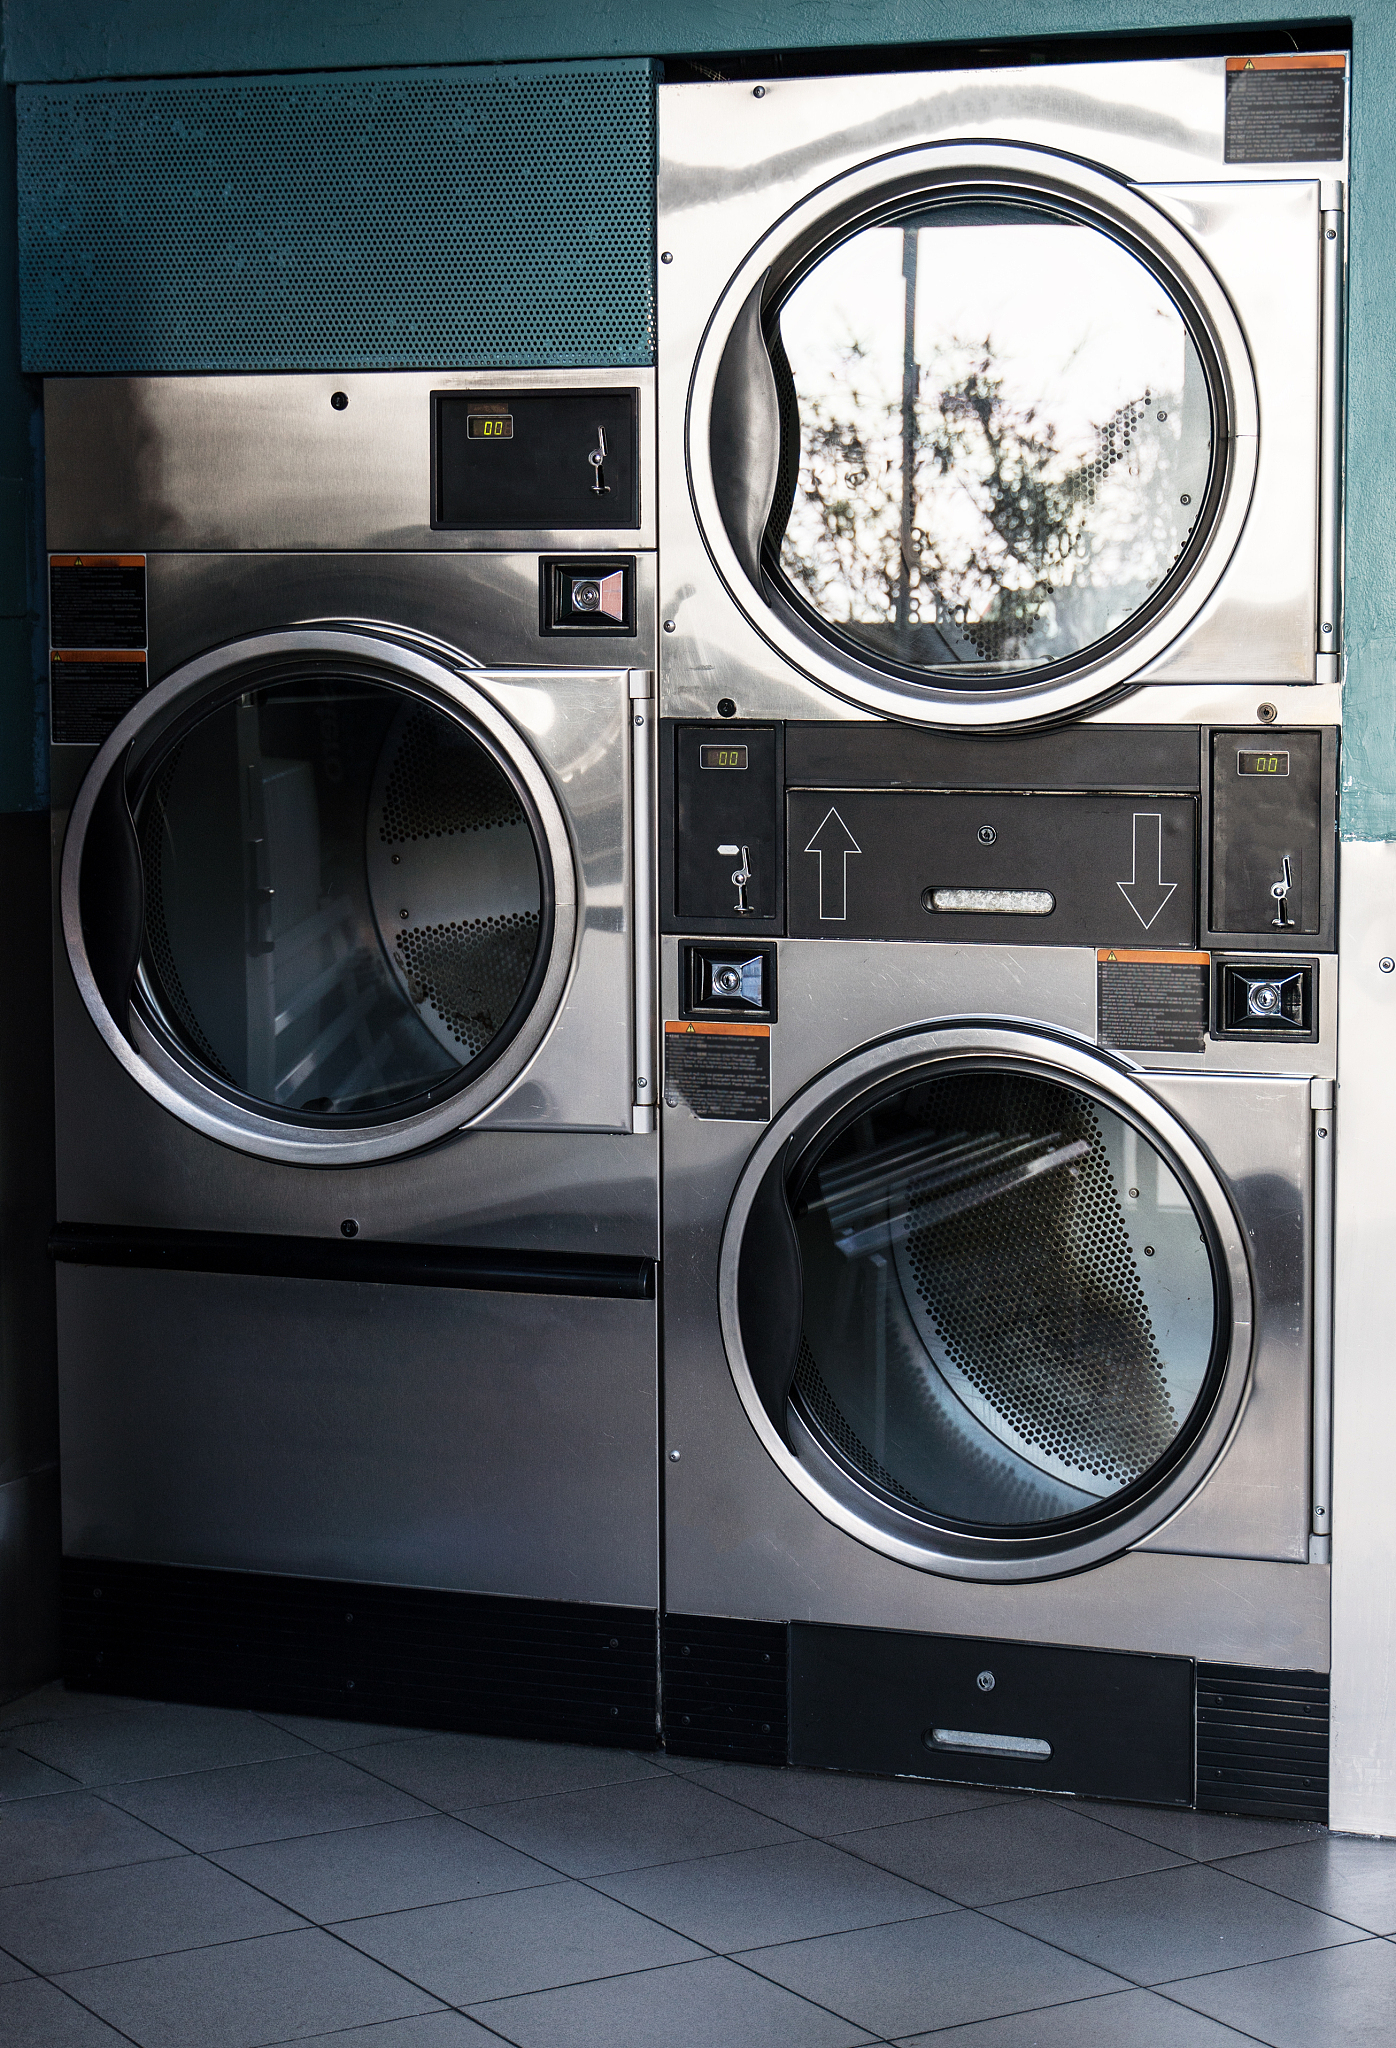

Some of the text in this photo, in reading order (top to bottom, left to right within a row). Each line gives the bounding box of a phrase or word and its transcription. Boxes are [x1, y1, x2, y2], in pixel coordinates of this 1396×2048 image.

[484, 421, 503, 435] 00
[719, 751, 738, 766] 00
[1256, 757, 1278, 772] 00
